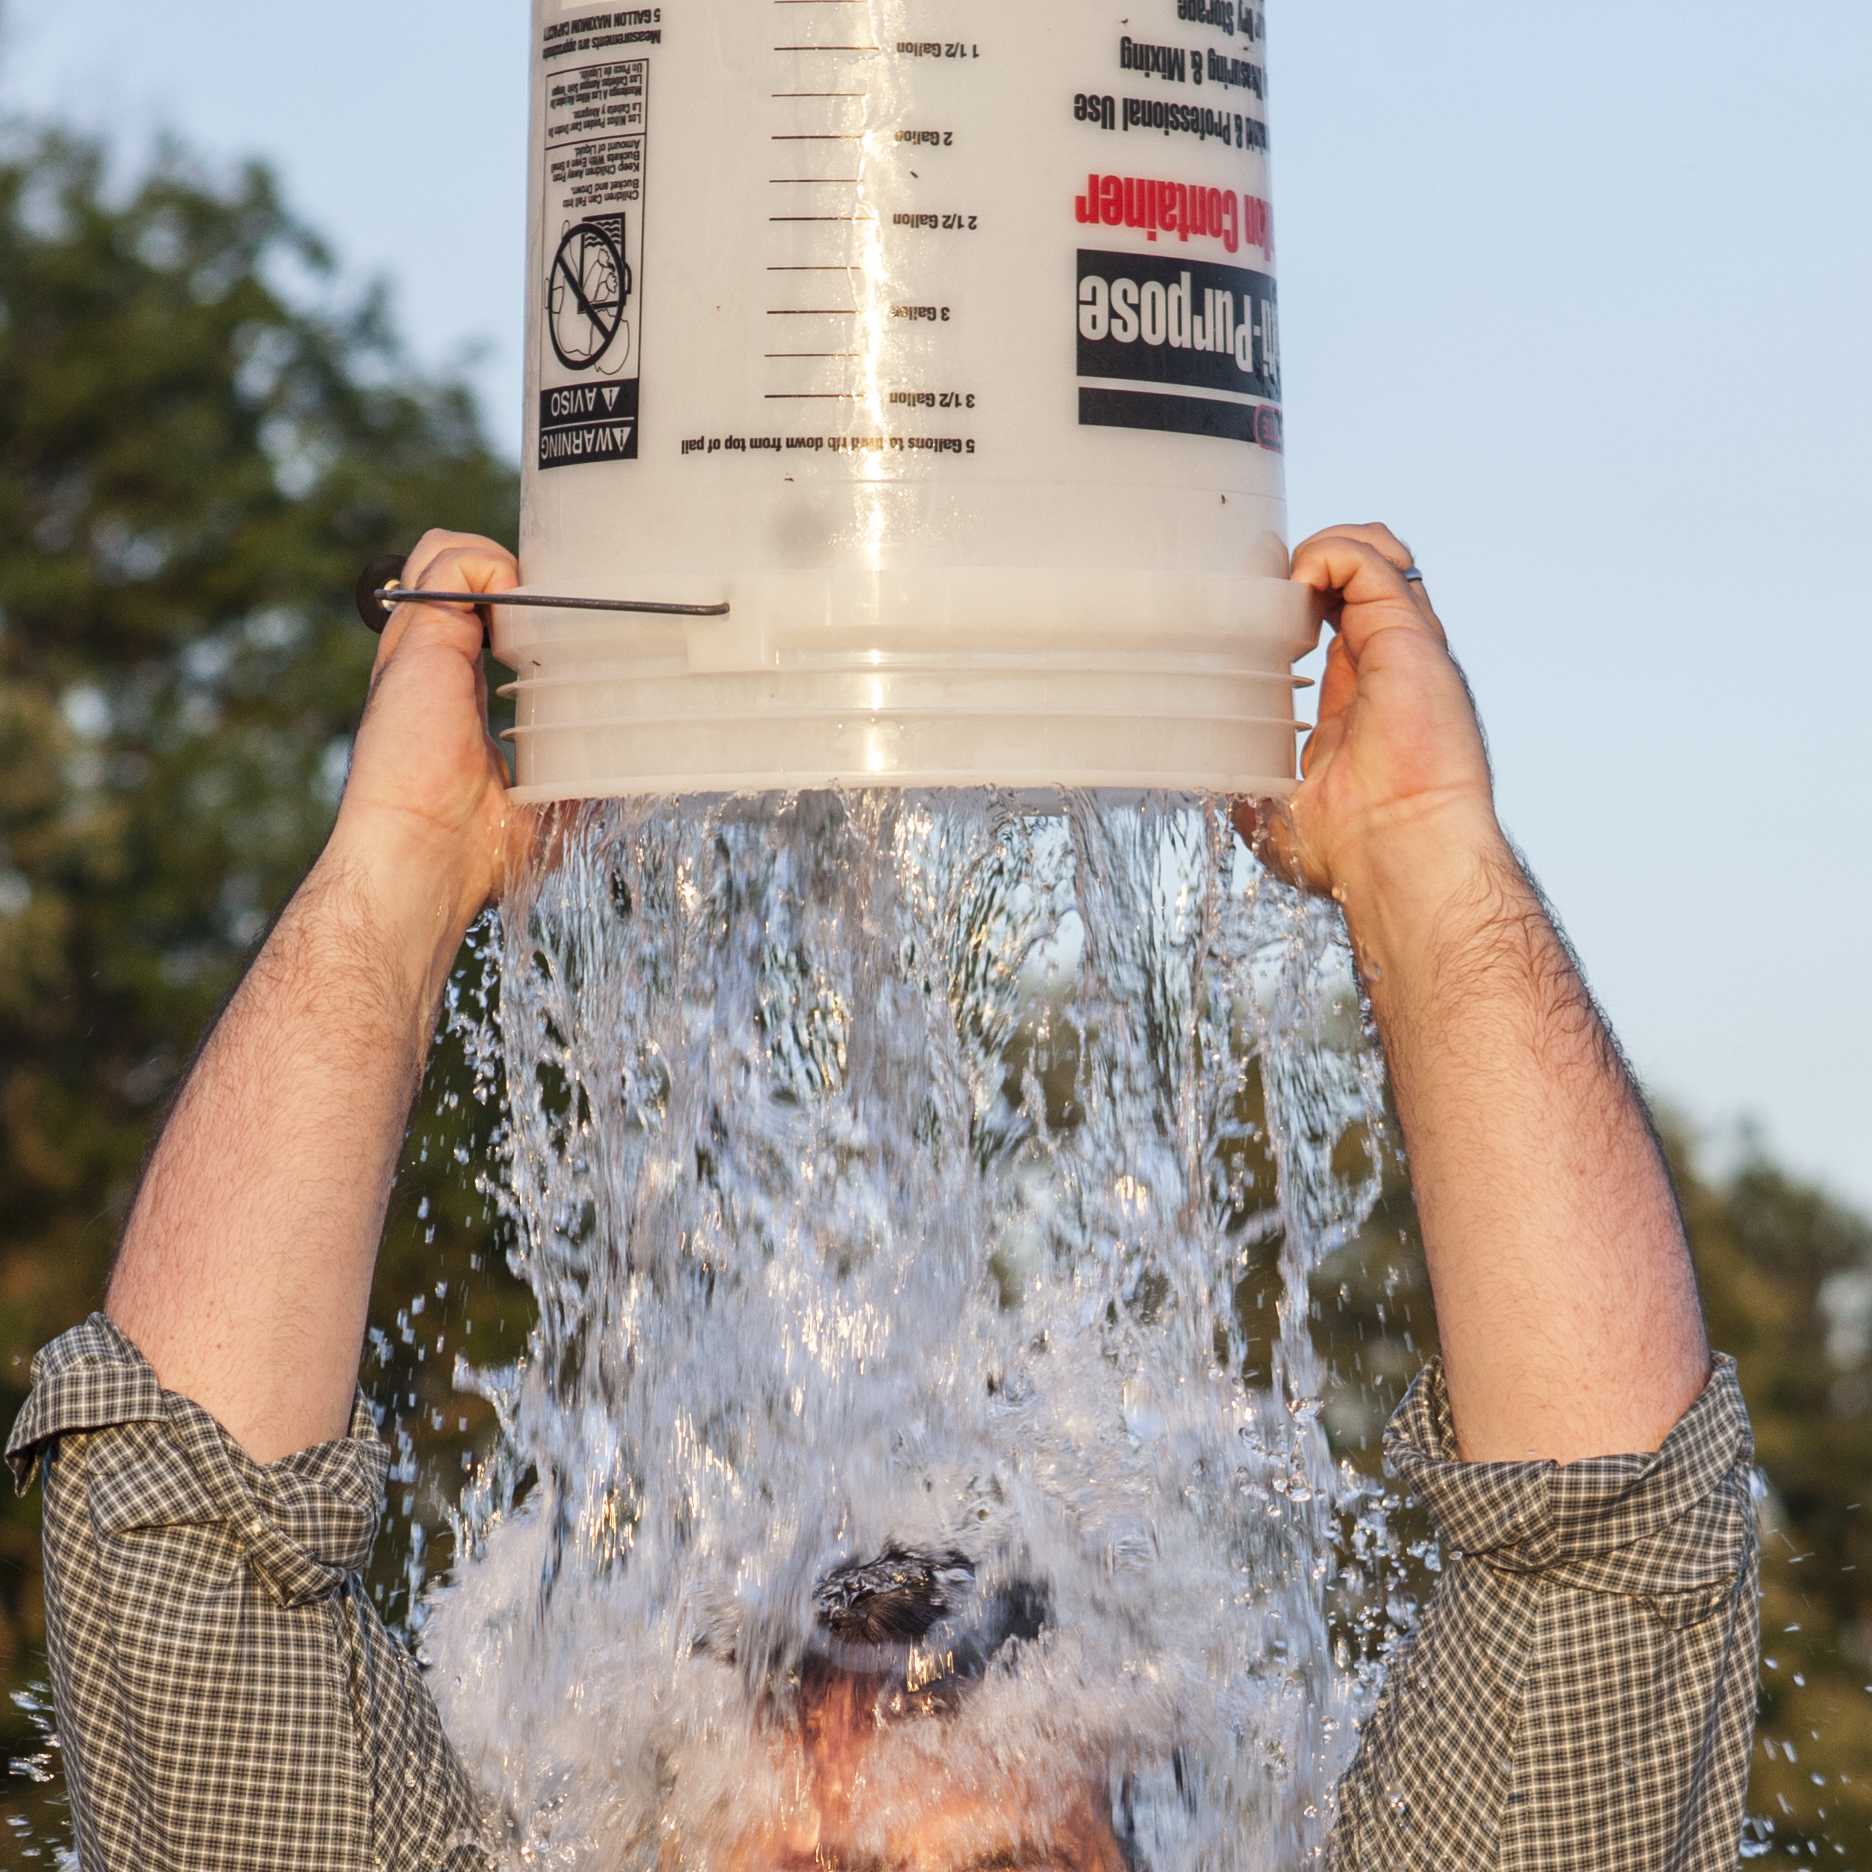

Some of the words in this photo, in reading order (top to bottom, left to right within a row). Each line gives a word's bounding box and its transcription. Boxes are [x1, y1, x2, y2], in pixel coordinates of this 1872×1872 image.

[613, 10, 652, 28] GALLON
[653, 8, 661, 22] 5
[592, 30, 661, 51] Measurements
[896, 42, 942, 57] Gallon
[945, 42, 967, 58] 1/2
[972, 44, 980, 58] 1
[1120, 36, 1185, 83] Mixing
[1190, 51, 1202, 85] &
[1073, 93, 1115, 130] Use
[1122, 98, 1231, 147] Professional
[1234, 114, 1242, 148] &
[608, 139, 641, 151] Amount
[943, 132, 953, 146] 2
[598, 143, 606, 153] of
[607, 151, 640, 163] Buckets
[585, 164, 616, 177] Children
[617, 160, 640, 173] Keep
[595, 182, 608, 192] and
[610, 179, 639, 190] Bucket
[604, 189, 639, 202] Children
[893, 214, 939, 229] Gallon
[942, 214, 964, 229] 1/2
[1075, 174, 1238, 254] Container
[968, 216, 977, 230] 2
[940, 307, 950, 321] 3
[551, 387, 597, 417] AVISO
[889, 393, 935, 407] Gallon
[939, 392, 962, 408] 1/2
[965, 394, 975, 408] 3
[541, 427, 613, 460] WARNING
[681, 436, 704, 455] pail
[707, 439, 721, 453] of
[724, 435, 746, 452] top
[750, 438, 781, 452] from
[786, 437, 823, 451] down
[908, 438, 962, 453] Gallons
[965, 439, 975, 454] 5
